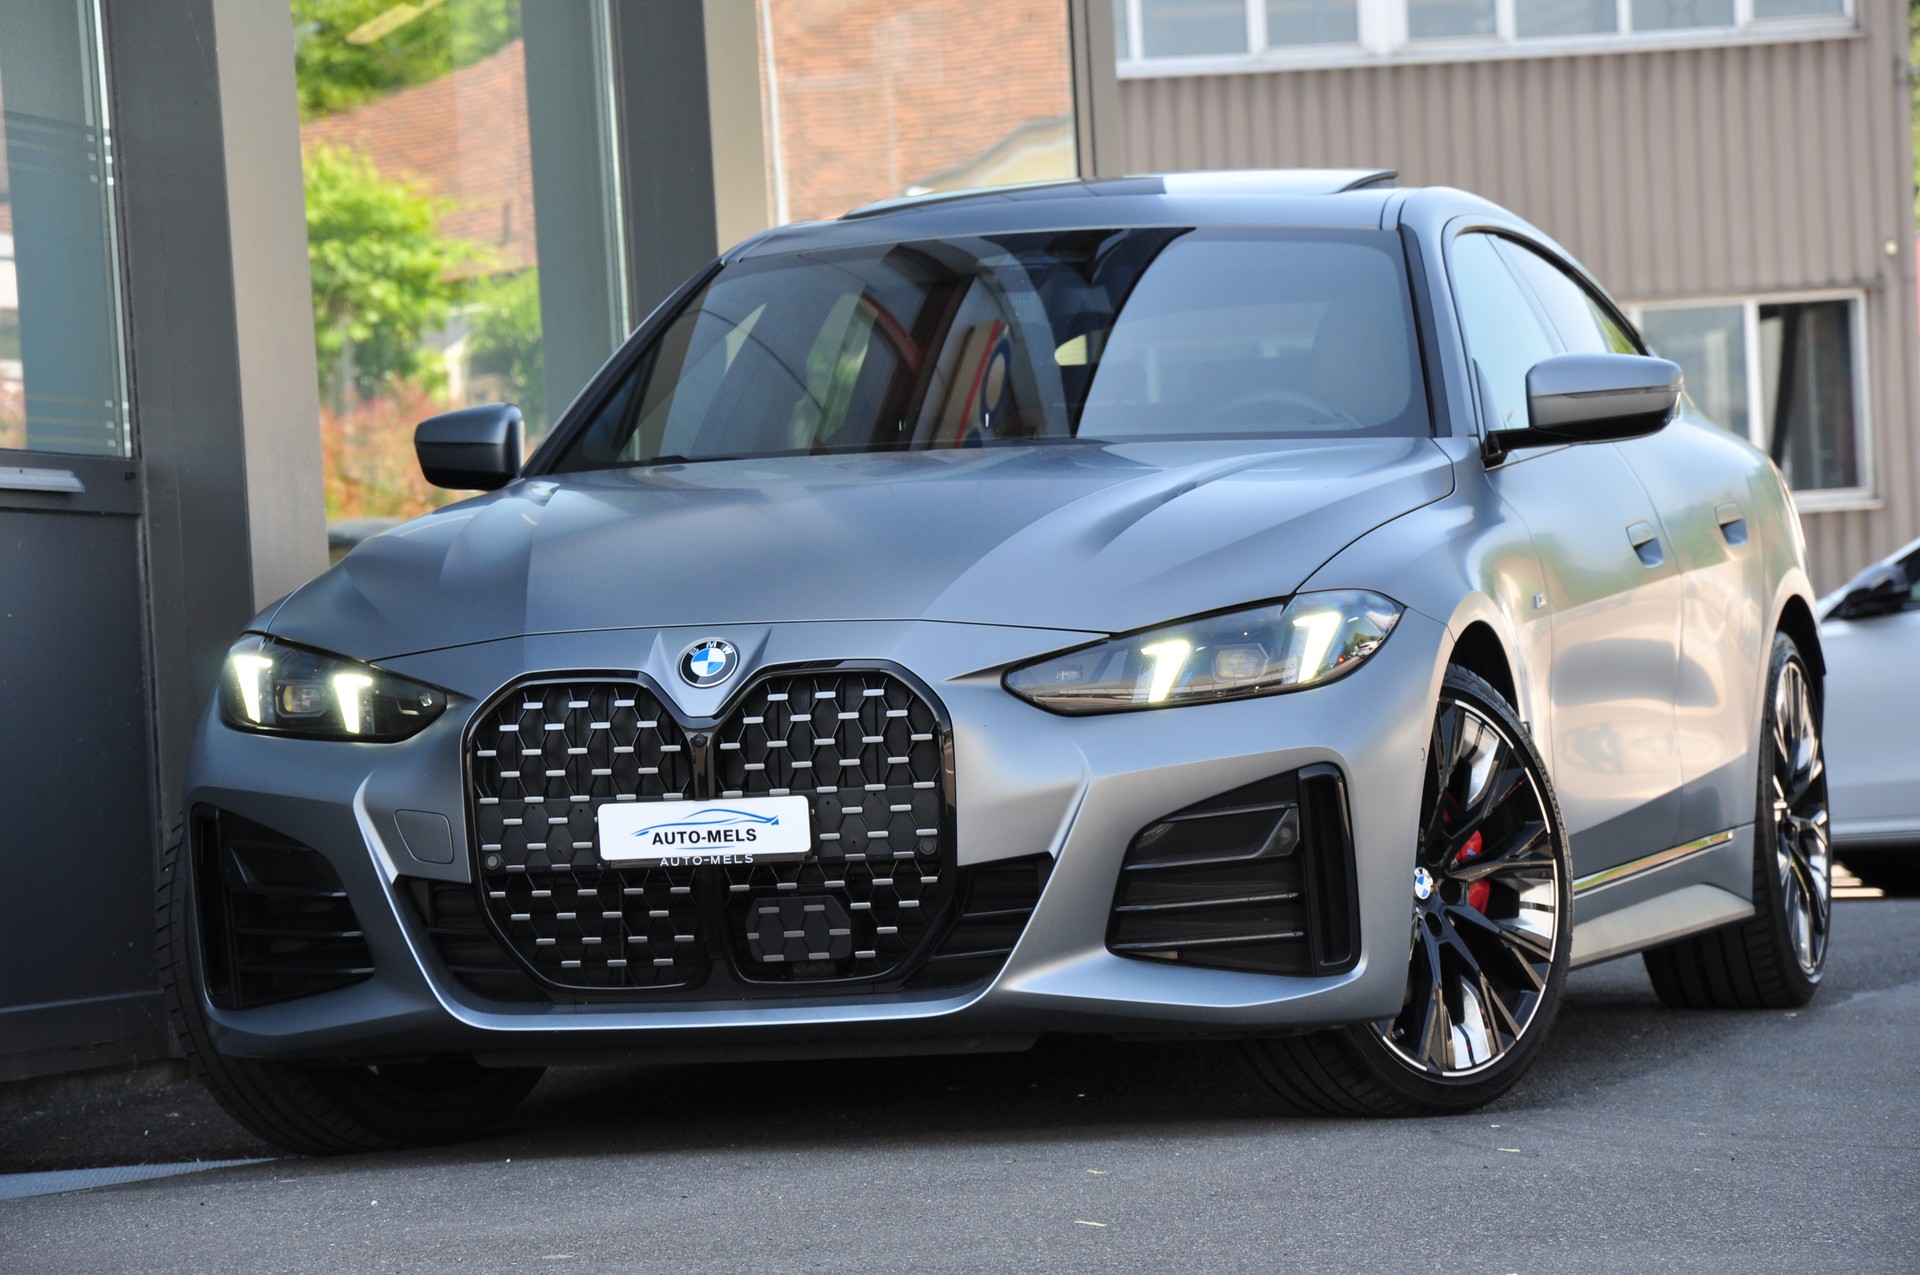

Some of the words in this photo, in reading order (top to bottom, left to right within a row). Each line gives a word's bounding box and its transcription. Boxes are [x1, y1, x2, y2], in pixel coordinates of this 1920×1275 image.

[688, 640, 734, 656] BMW
[652, 828, 757, 845] AUTO-MELS
[660, 854, 754, 867] AUTO-MELS
